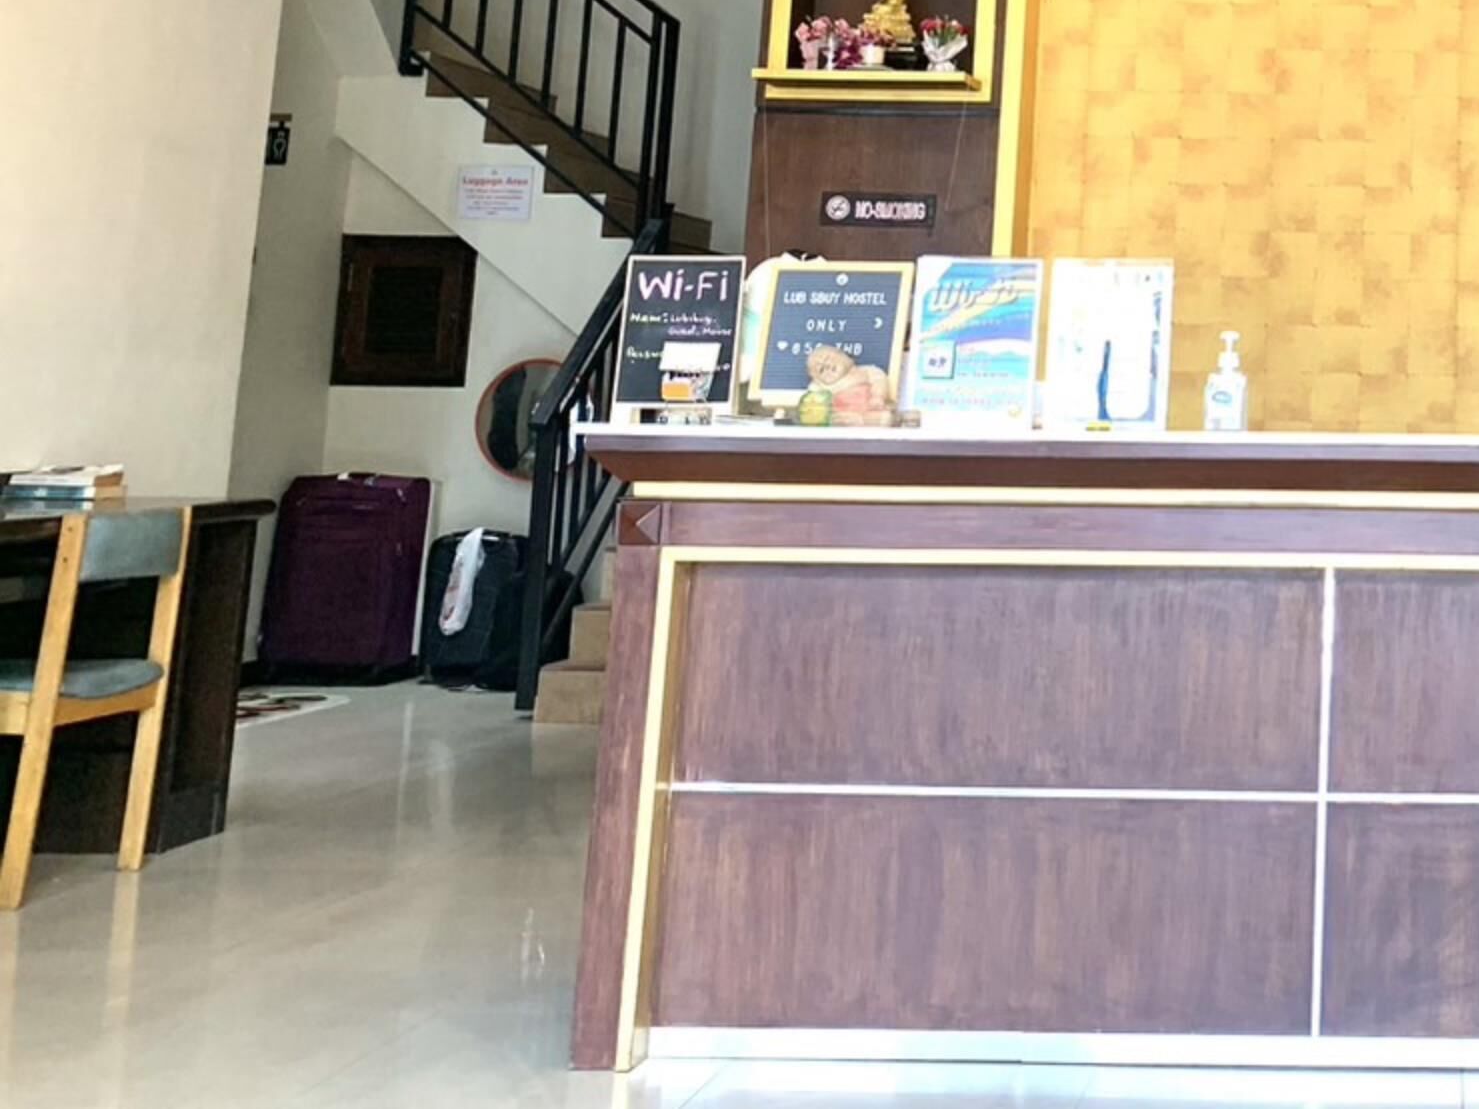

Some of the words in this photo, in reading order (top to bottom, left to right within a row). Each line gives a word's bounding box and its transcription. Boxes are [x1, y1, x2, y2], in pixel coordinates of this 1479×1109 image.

[638, 268, 729, 302] Wi-Fi
[783, 290, 807, 305] LUB
[809, 291, 842, 305] SBUY
[843, 291, 888, 306] HOSTEL
[805, 318, 848, 332] ONLY
